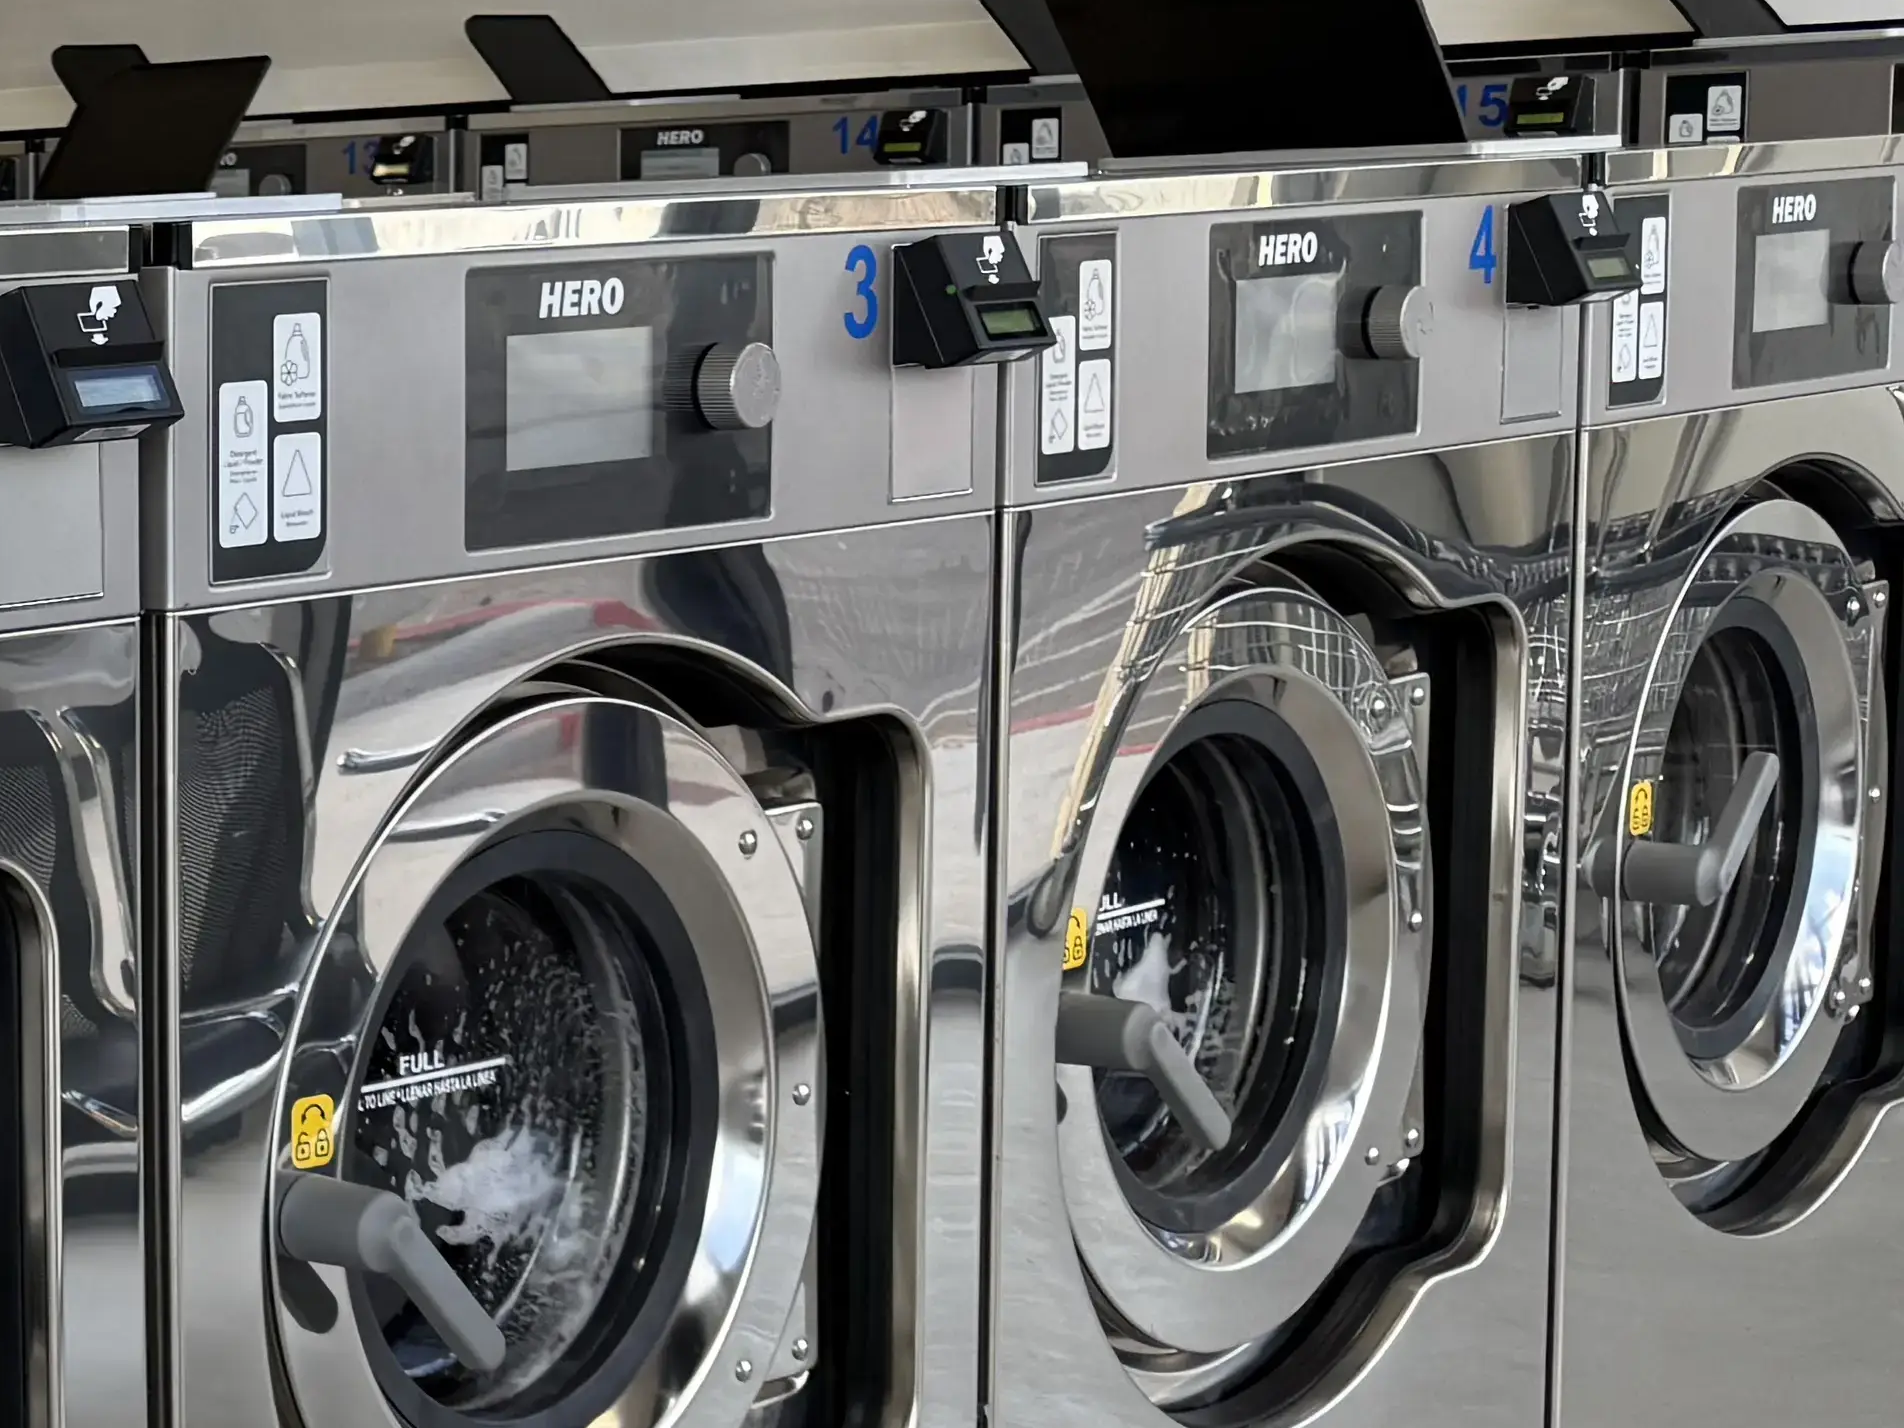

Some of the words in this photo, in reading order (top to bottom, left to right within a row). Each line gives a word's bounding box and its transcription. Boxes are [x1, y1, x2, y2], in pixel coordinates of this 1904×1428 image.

[657, 129, 704, 146] HERO
[832, 115, 879, 155] 14
[1772, 193, 1817, 224] HERO
[1258, 231, 1318, 266] HERO
[1469, 205, 1496, 284] 4
[539, 277, 624, 318] HERO
[843, 244, 878, 339] 3
[1099, 891, 1122, 912] ULL
[399, 1049, 445, 1076] FULL
